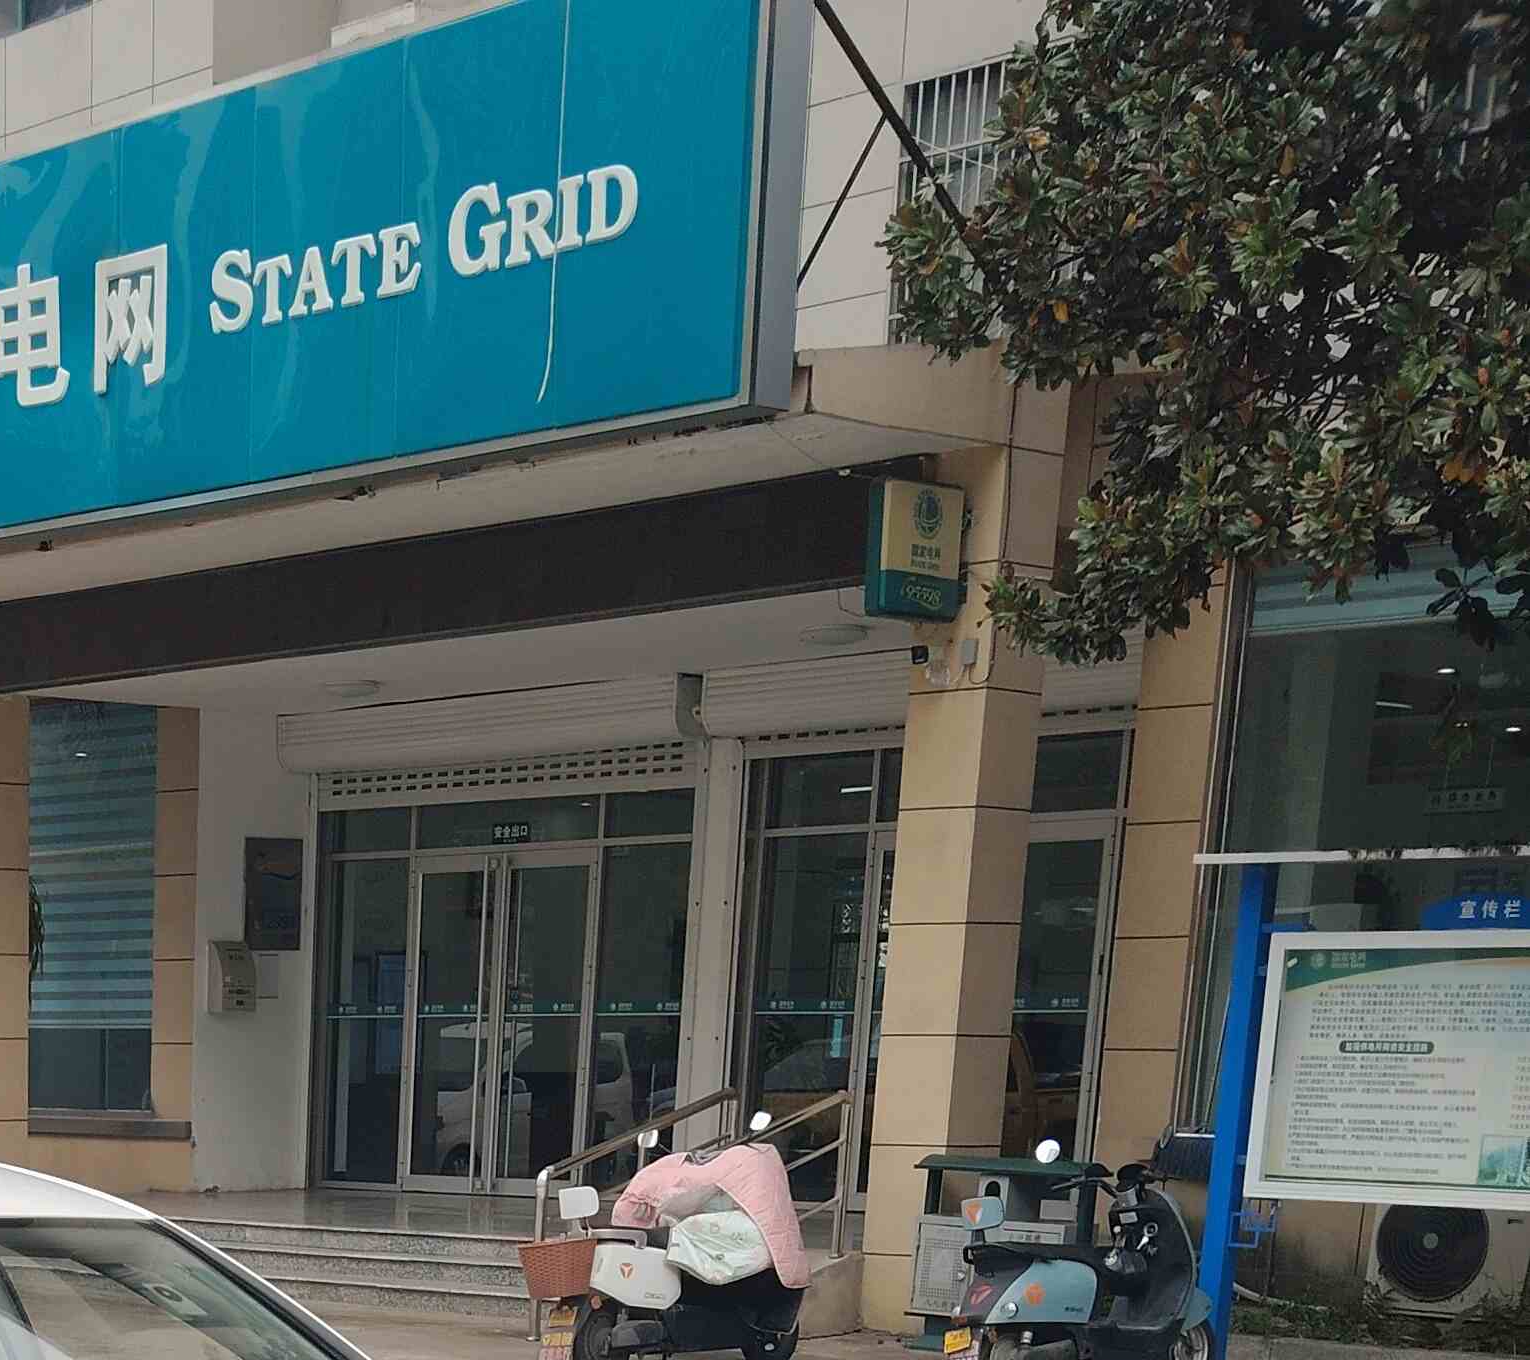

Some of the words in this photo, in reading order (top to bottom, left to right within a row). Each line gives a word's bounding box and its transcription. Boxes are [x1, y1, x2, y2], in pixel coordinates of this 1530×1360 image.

[209, 221, 422, 336] STATE
[447, 162, 639, 279] GRID
[493, 824, 528, 839] 安全出口
[1458, 899, 1522, 919] 宣传栏
